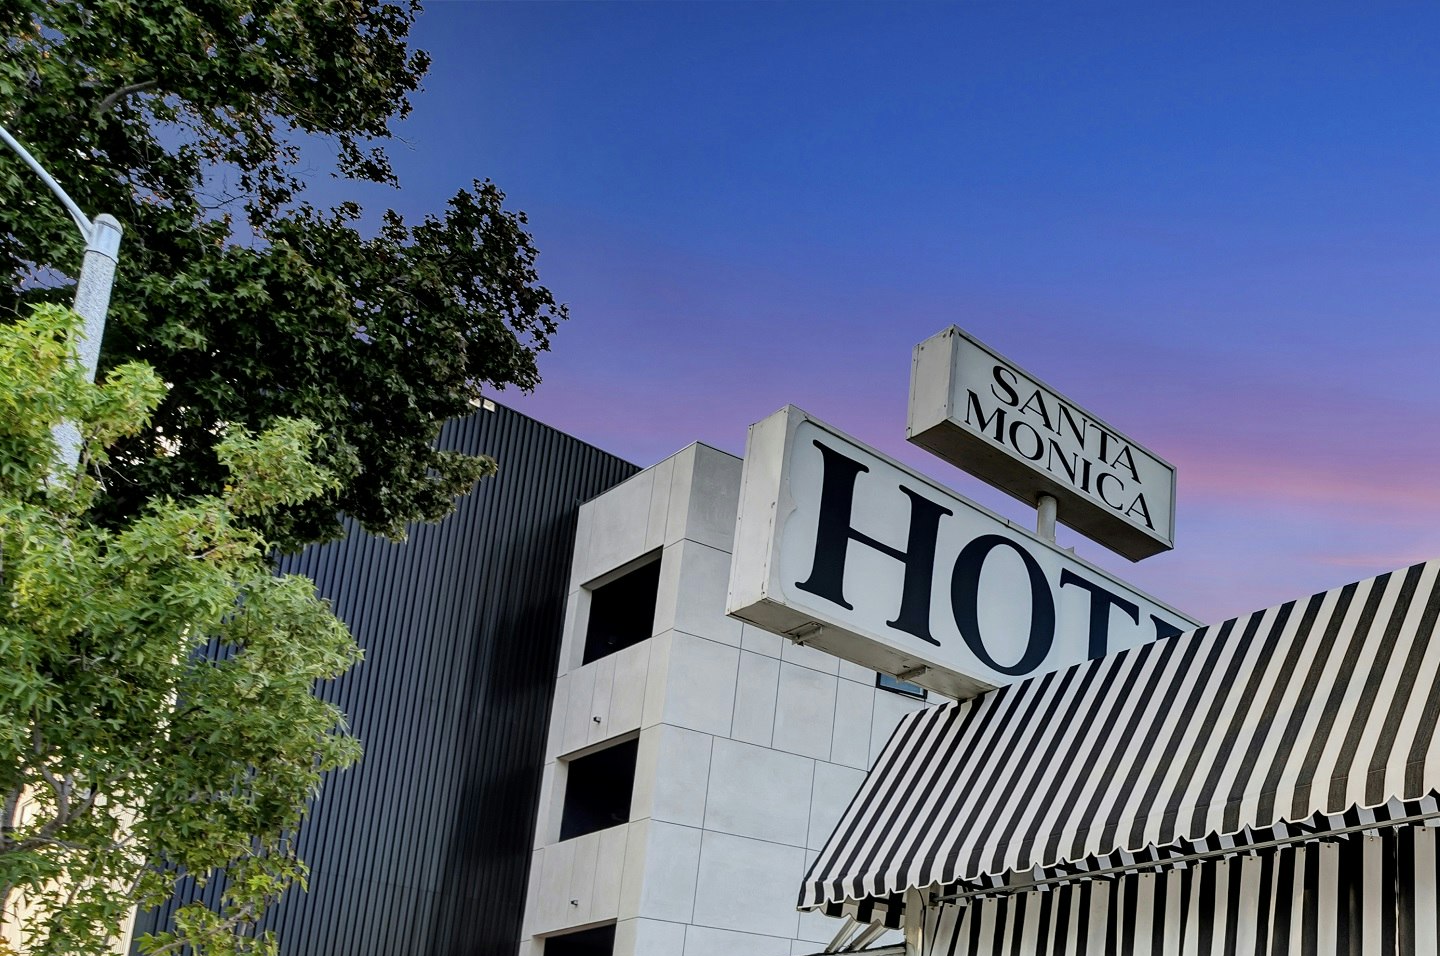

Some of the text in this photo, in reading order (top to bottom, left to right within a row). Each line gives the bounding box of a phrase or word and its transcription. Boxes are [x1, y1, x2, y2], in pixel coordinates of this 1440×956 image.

[964, 388, 1156, 531] MONICA
[991, 365, 1142, 484] SANTA
[794, 439, 1185, 677] HOT
